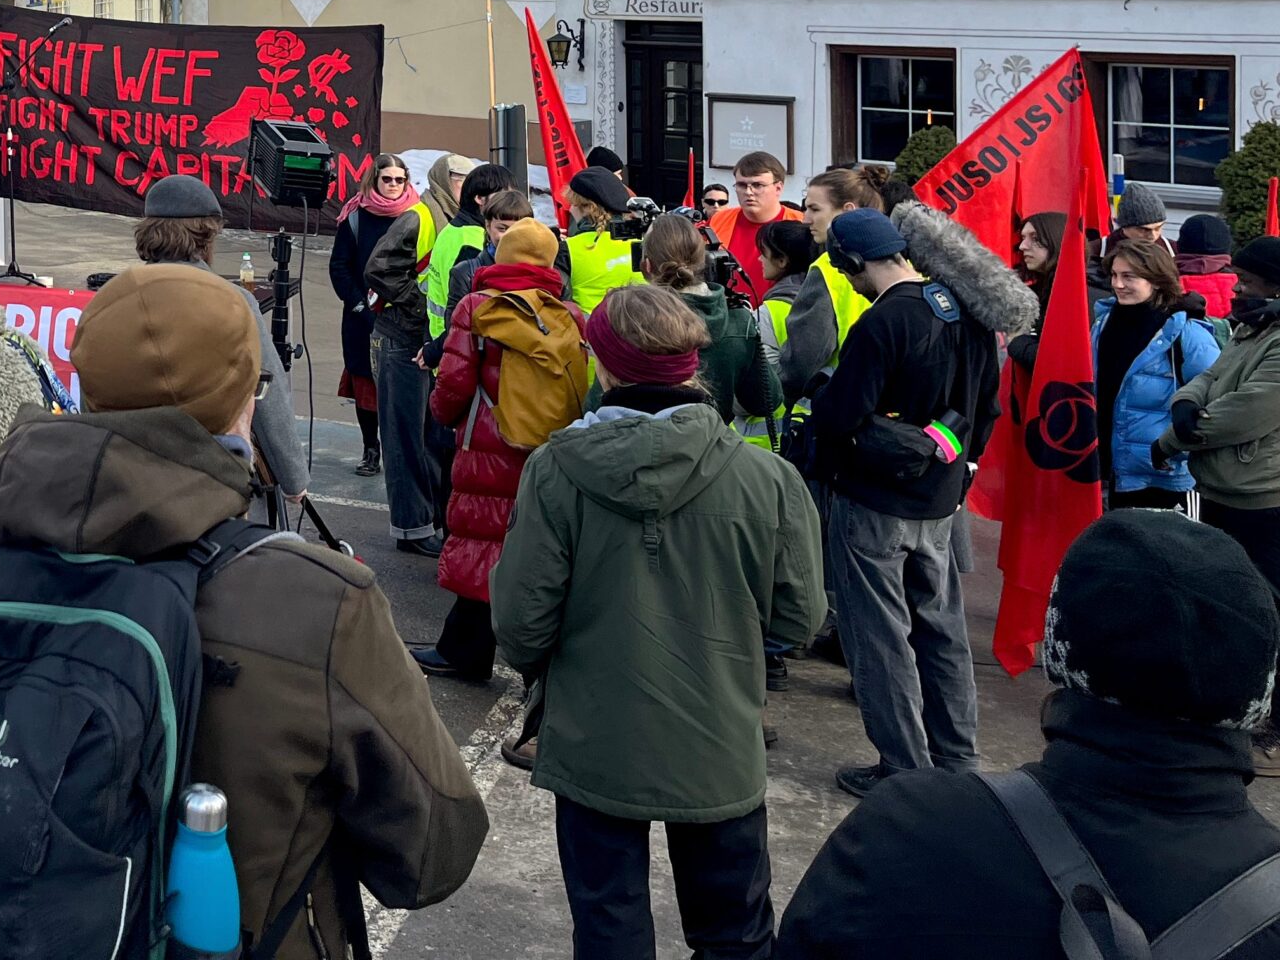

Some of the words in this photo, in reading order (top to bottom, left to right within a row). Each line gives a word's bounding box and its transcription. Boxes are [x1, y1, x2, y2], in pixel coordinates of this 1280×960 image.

[113, 44, 220, 107] WEF
[88, 107, 199, 148] TRUMP
[115, 146, 373, 202] CAPITAM
[935, 145, 1008, 216] JUSO
[1014, 103, 1052, 147] JS
